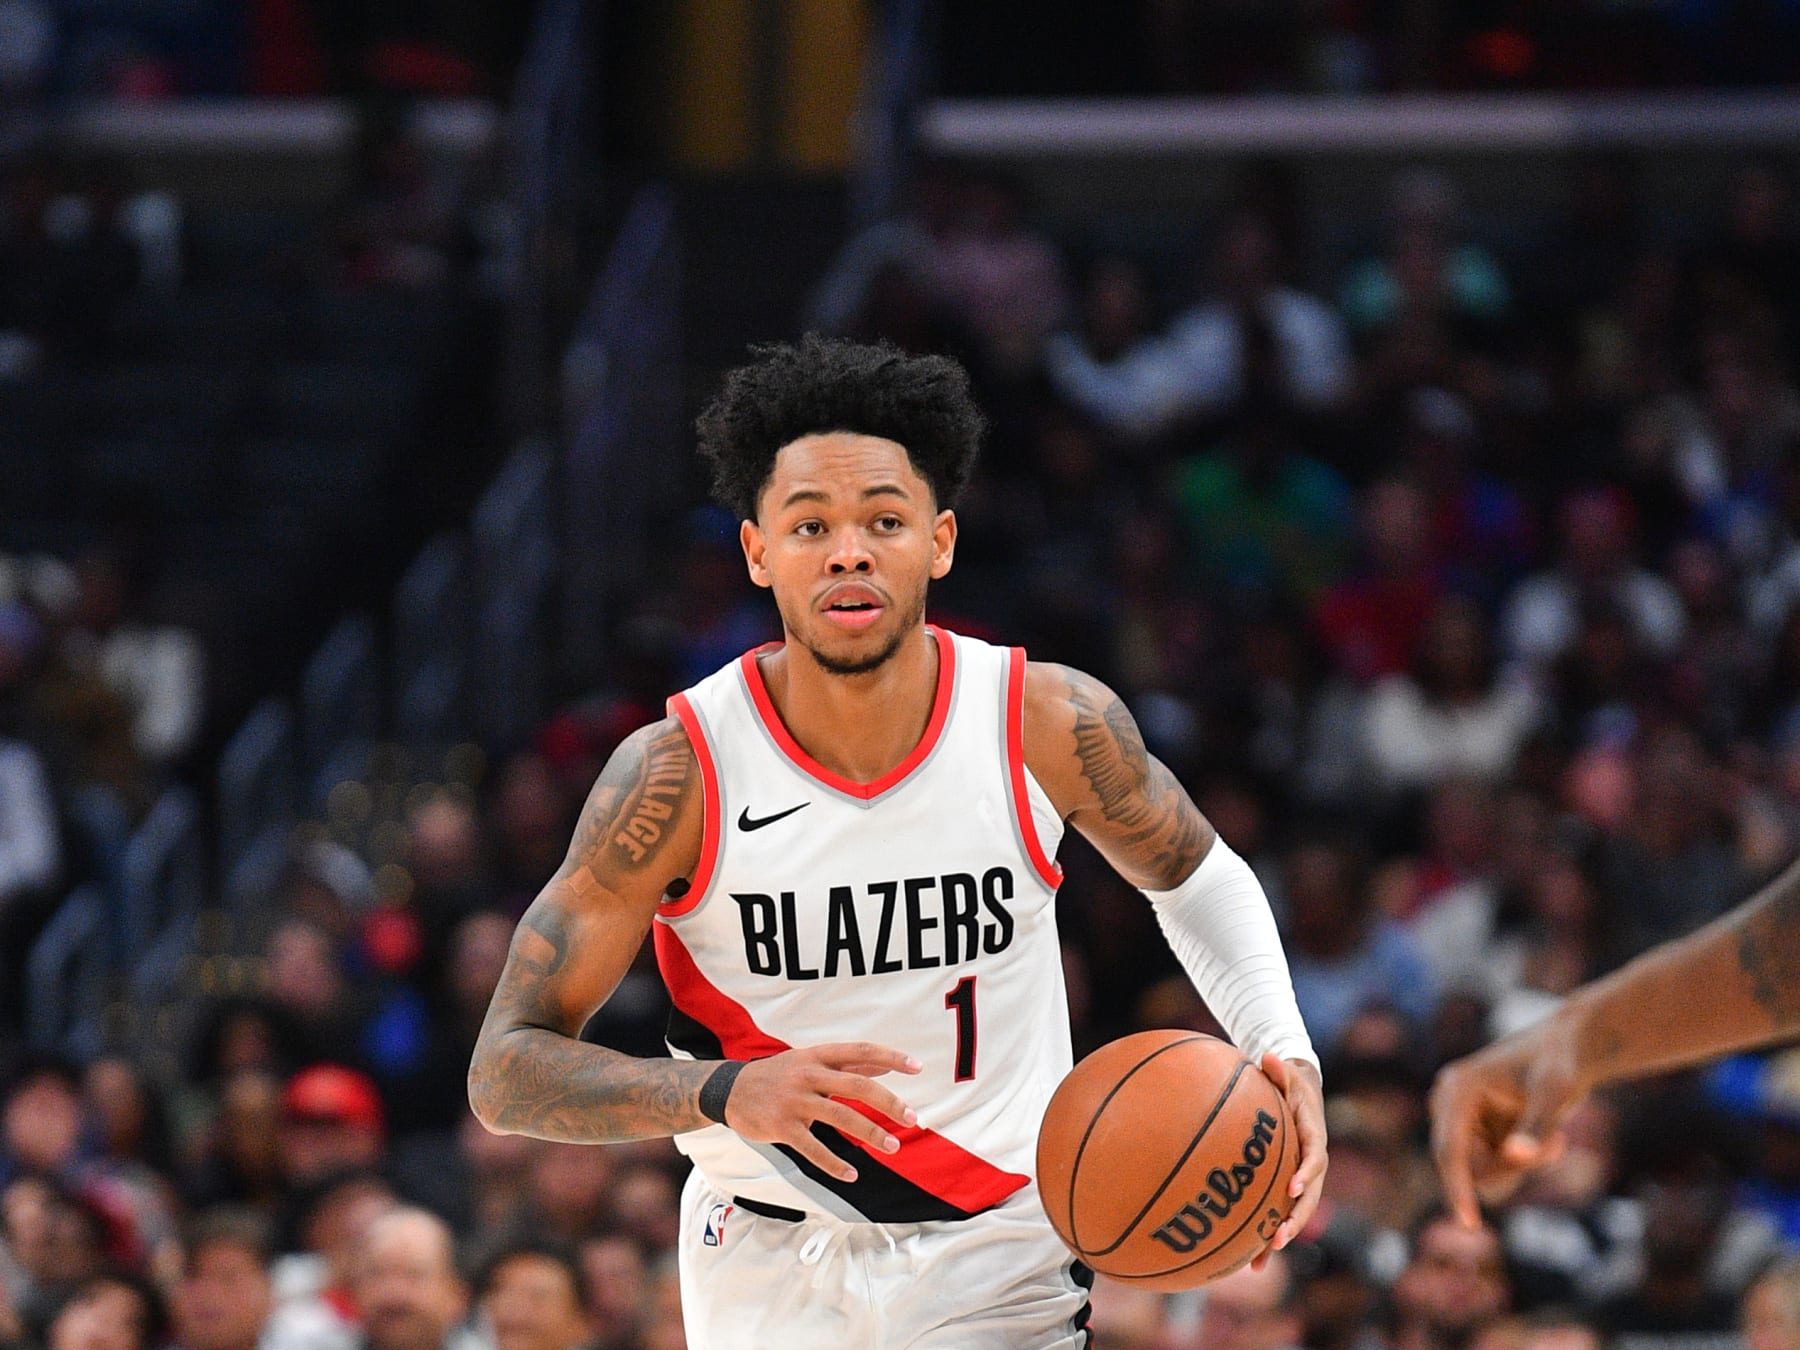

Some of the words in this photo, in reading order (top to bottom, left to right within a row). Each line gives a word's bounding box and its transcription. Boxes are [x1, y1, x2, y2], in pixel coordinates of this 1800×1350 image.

[729, 866, 1015, 981] BLAZERS
[945, 975, 978, 1083] 1
[1150, 1107, 1278, 1254] Wilson
